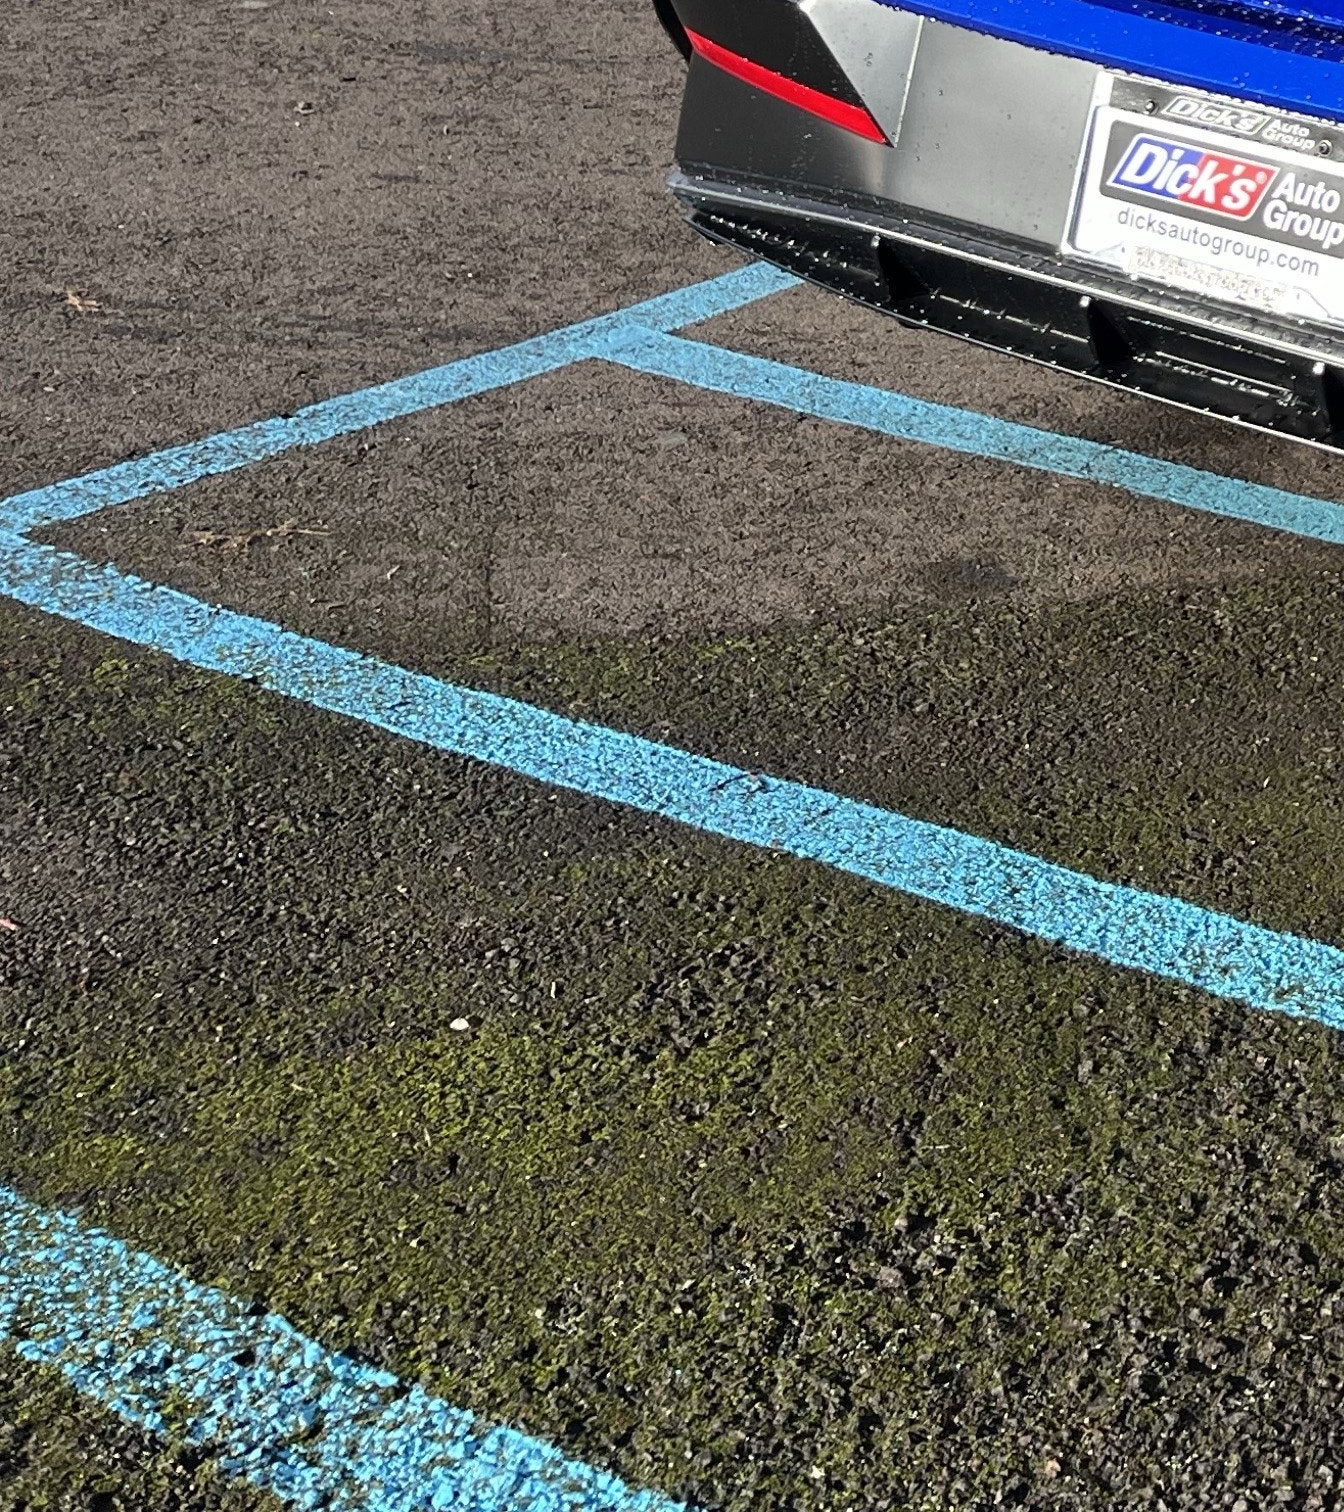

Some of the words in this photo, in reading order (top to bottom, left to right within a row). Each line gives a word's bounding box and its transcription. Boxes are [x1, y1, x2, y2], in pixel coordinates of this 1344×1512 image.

[1261, 127, 1316, 151] Group
[1269, 119, 1311, 138] Auto
[1119, 142, 1258, 211] Dick's
[1271, 172, 1341, 214] Auto
[1117, 206, 1320, 277] dicksautogroup.com
